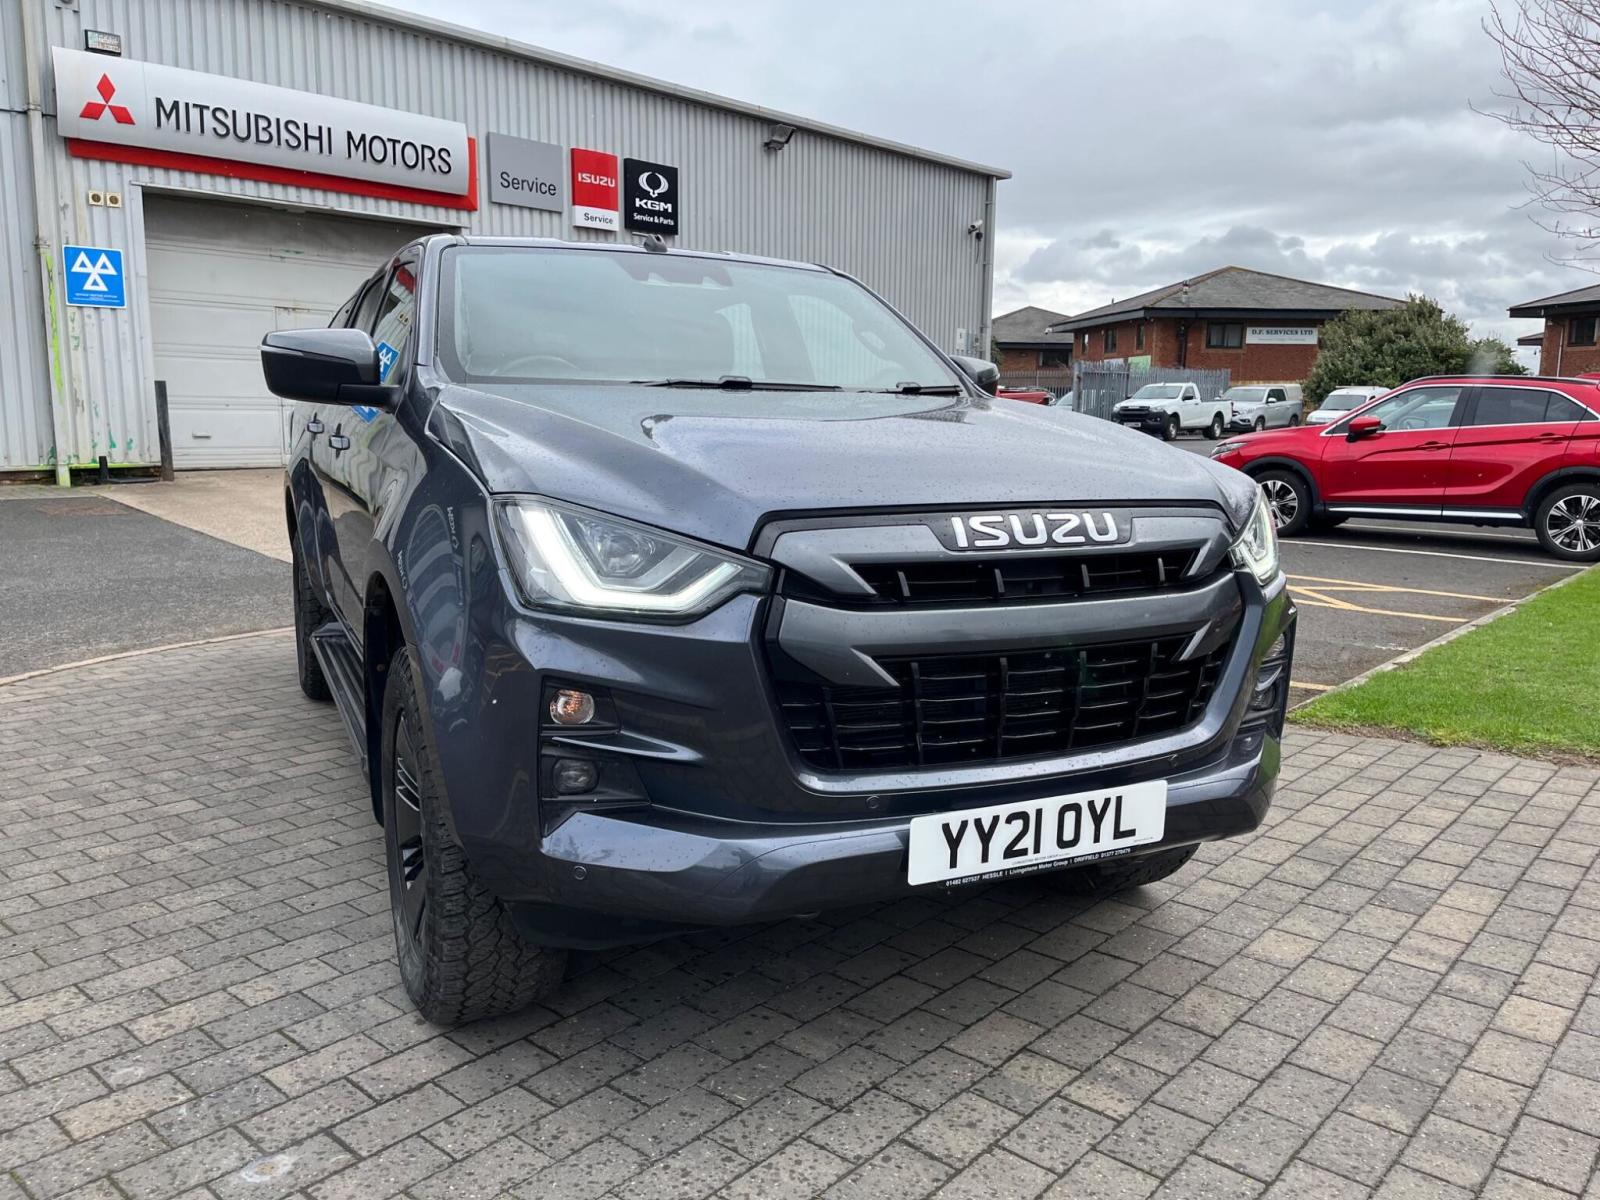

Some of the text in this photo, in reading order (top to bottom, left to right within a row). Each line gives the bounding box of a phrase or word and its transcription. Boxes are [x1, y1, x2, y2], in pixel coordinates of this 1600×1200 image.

[154, 97, 452, 175] MITSUBISHI MOTORS
[499, 171, 557, 197] Service
[577, 172, 616, 188] ISUZU
[635, 197, 673, 213] KGM
[584, 212, 614, 225] Service
[633, 212, 675, 226] Service & Parts
[1265, 328, 1299, 336] SERVICES
[951, 511, 1119, 548] ISUZU
[941, 795, 1137, 870] YY21 OYL
[982, 871, 1004, 880] HESSLE
[1039, 862, 1053, 870] Motor
[1053, 859, 1069, 868] Group
[1074, 854, 1100, 863] DRIFFIELD
